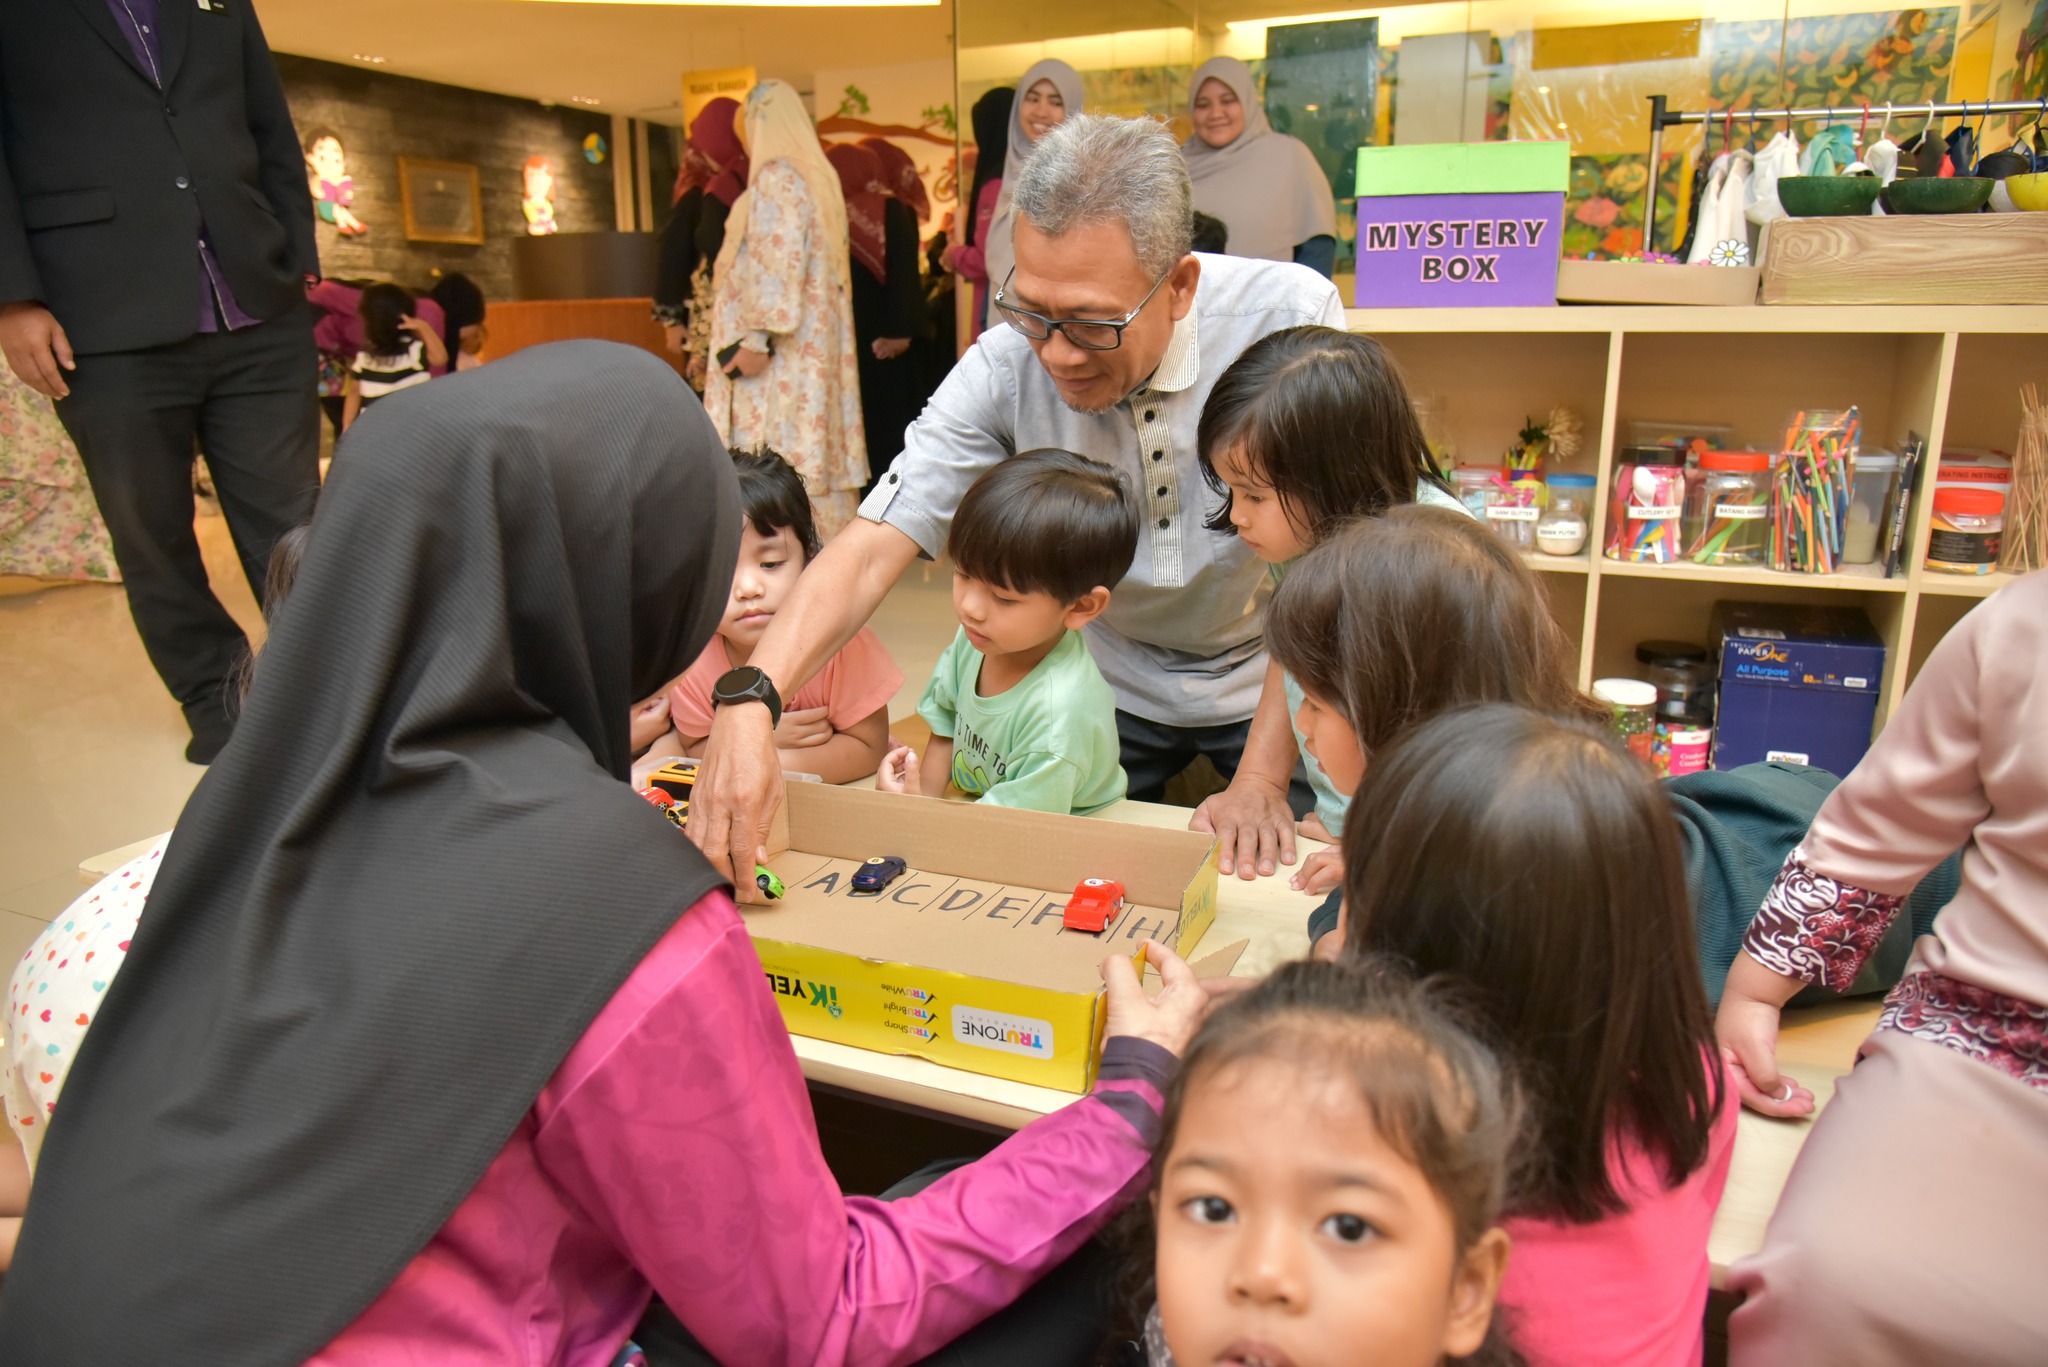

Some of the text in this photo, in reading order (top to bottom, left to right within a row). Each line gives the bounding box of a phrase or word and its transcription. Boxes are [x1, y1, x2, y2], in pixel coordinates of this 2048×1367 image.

[1367, 219, 1548, 251] MYSTERY
[1420, 255, 1500, 282] BOX
[1737, 664, 1750, 673] All
[1752, 664, 1789, 677] Purpose
[963, 723, 990, 762] TIME
[992, 752, 1007, 776] TO
[803, 871, 840, 894] A
[891, 884, 932, 905] C
[938, 889, 983, 911] D
[986, 896, 1030, 920] E
[1126, 916, 1165, 940] H
[765, 972, 807, 999] YEL
[881, 983, 927, 1000] TRUWhite
[883, 1002, 928, 1019] TRUBright
[961, 1015, 1040, 1033] TECHNOLOGY
[884, 1020, 930, 1038] TRUSharp
[962, 1020, 1043, 1049] TRUTONE
